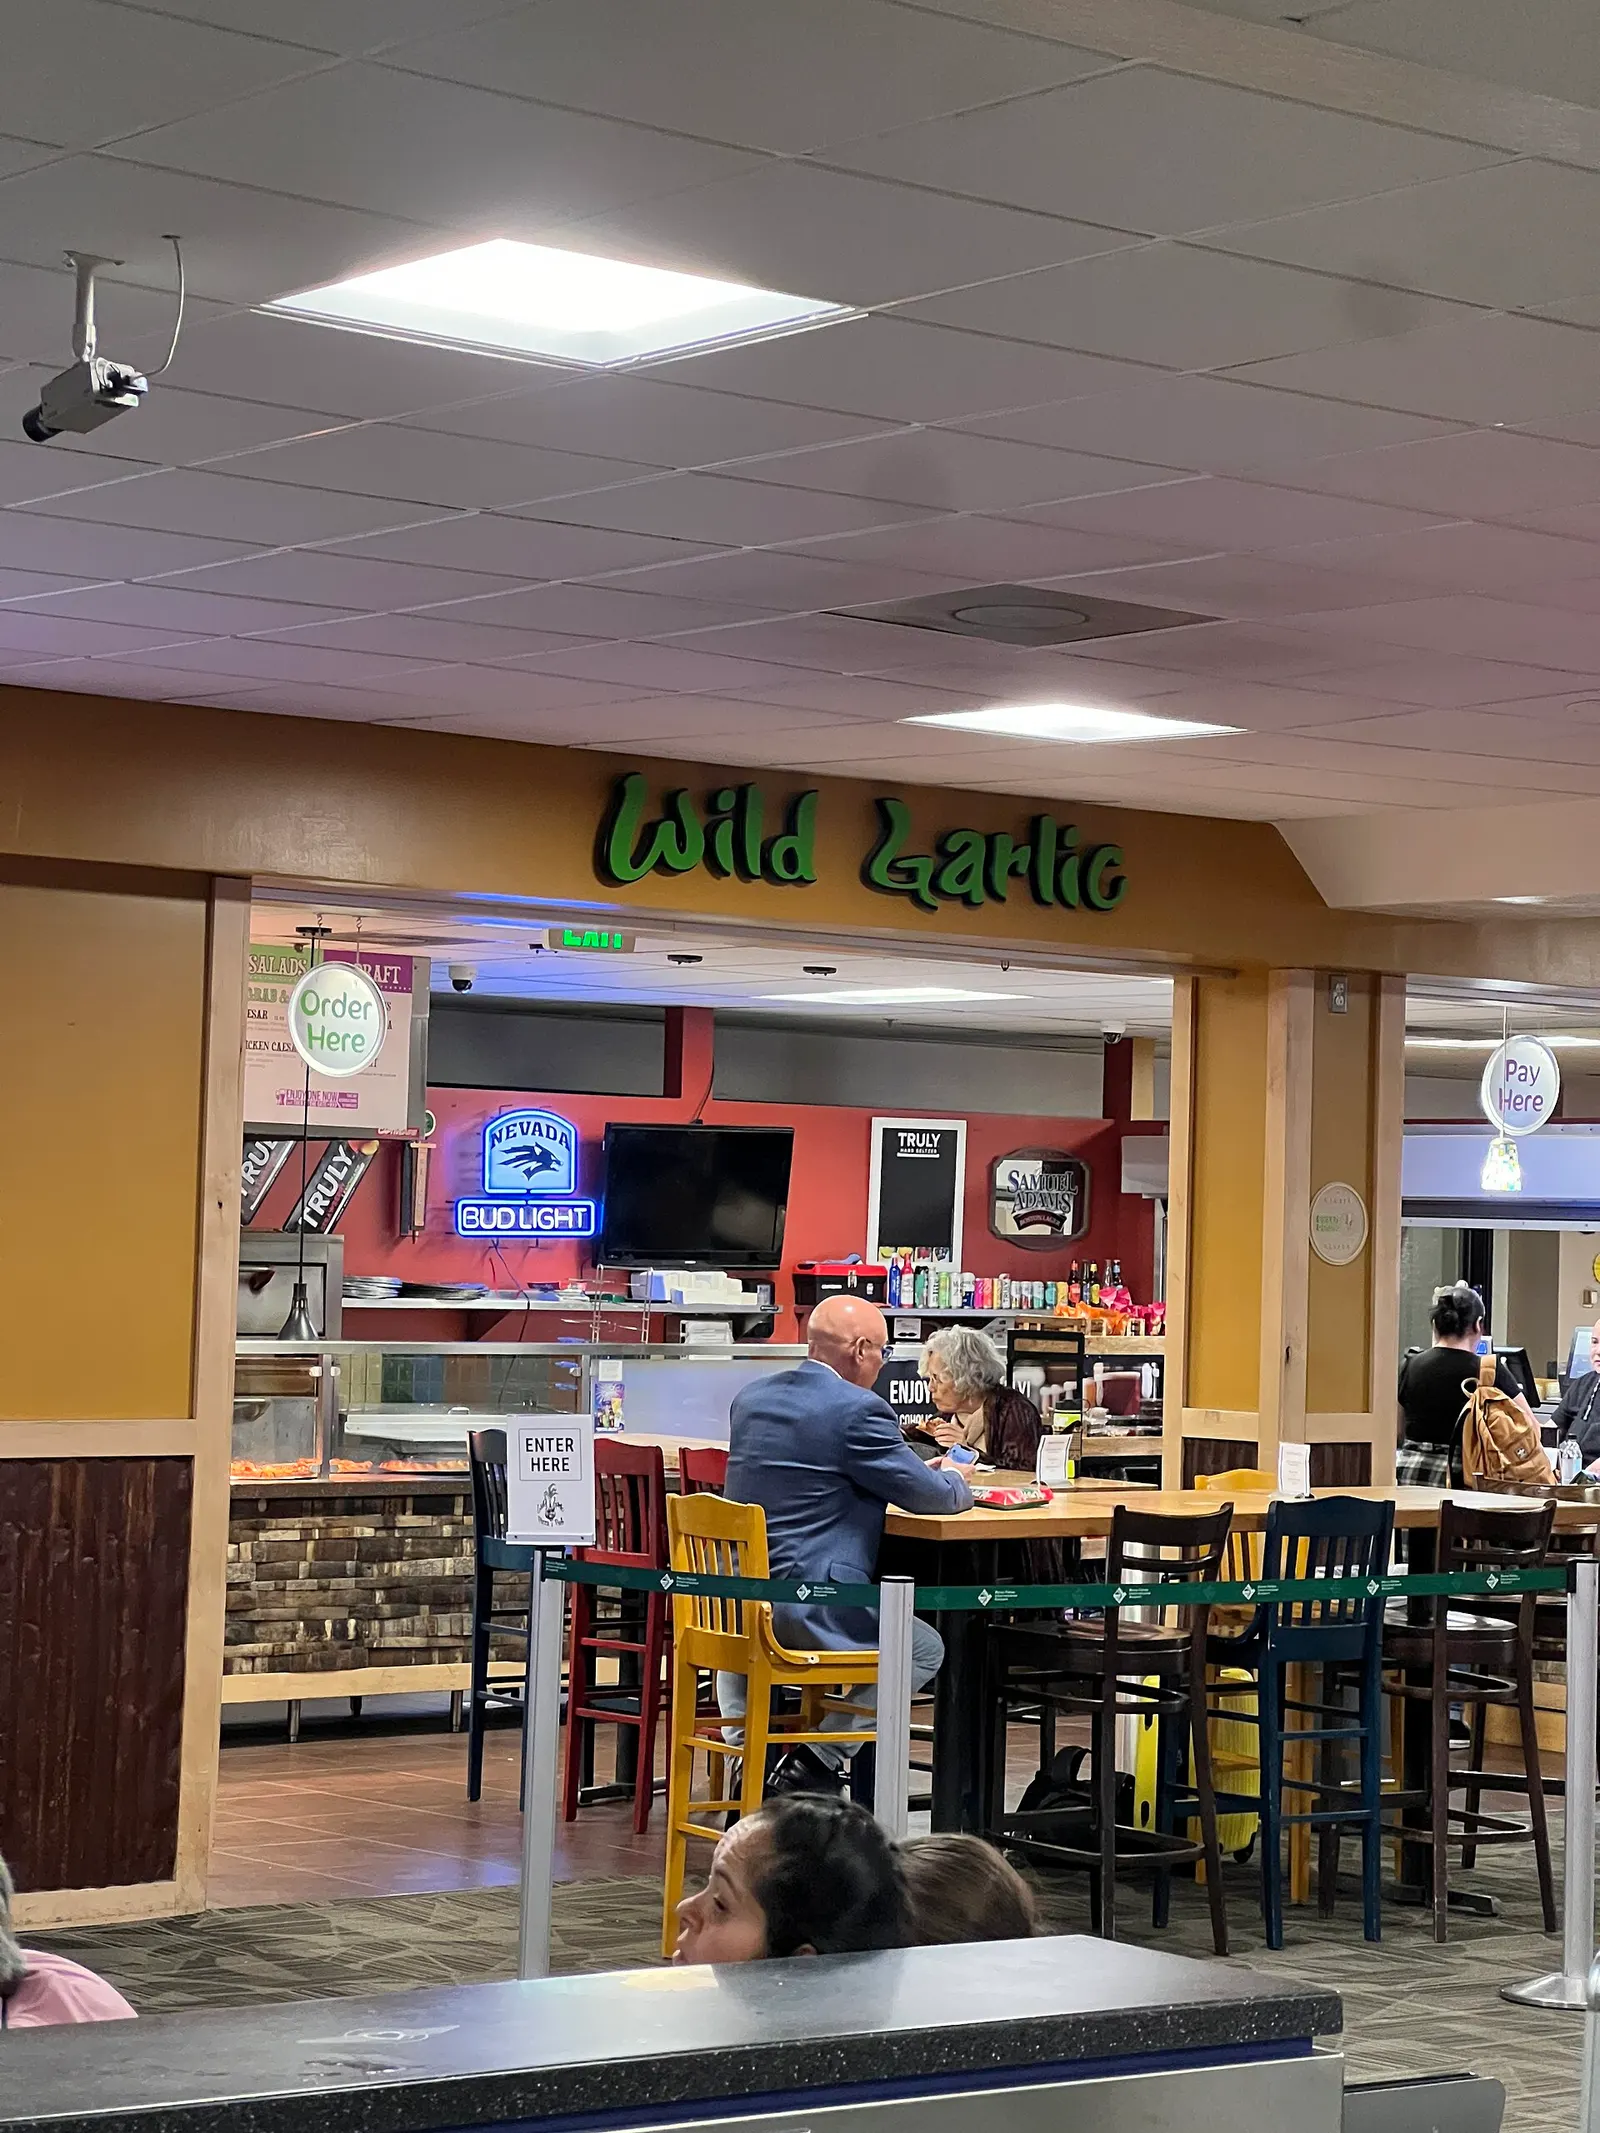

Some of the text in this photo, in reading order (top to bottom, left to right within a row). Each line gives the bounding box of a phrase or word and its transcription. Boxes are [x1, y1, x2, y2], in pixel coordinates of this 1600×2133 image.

[597, 771, 1128, 911] Wild Garlic
[249, 954, 307, 977] SALADS
[354, 963, 402, 984] RAFT
[247, 1008, 268, 1020] ESAR
[300, 989, 372, 1020] Order
[246, 1039, 297, 1053] ICKEN CAESA
[307, 1022, 366, 1053] Here
[1505, 1059, 1541, 1087] Pay
[1499, 1087, 1544, 1112] Here
[490, 1121, 570, 1151] NEVADA
[898, 1132, 941, 1148] TRULY
[241, 1140, 279, 1197] RUL
[299, 1144, 353, 1228] TRULY
[1007, 1169, 1078, 1195] SAMUEL
[1011, 1190, 1071, 1215] ADAMS
[462, 1206, 587, 1229] BUD LIGHT
[890, 1380, 931, 1404] ENJOY
[525, 1437, 574, 1452] ENTER
[531, 1457, 570, 1472] HERE
